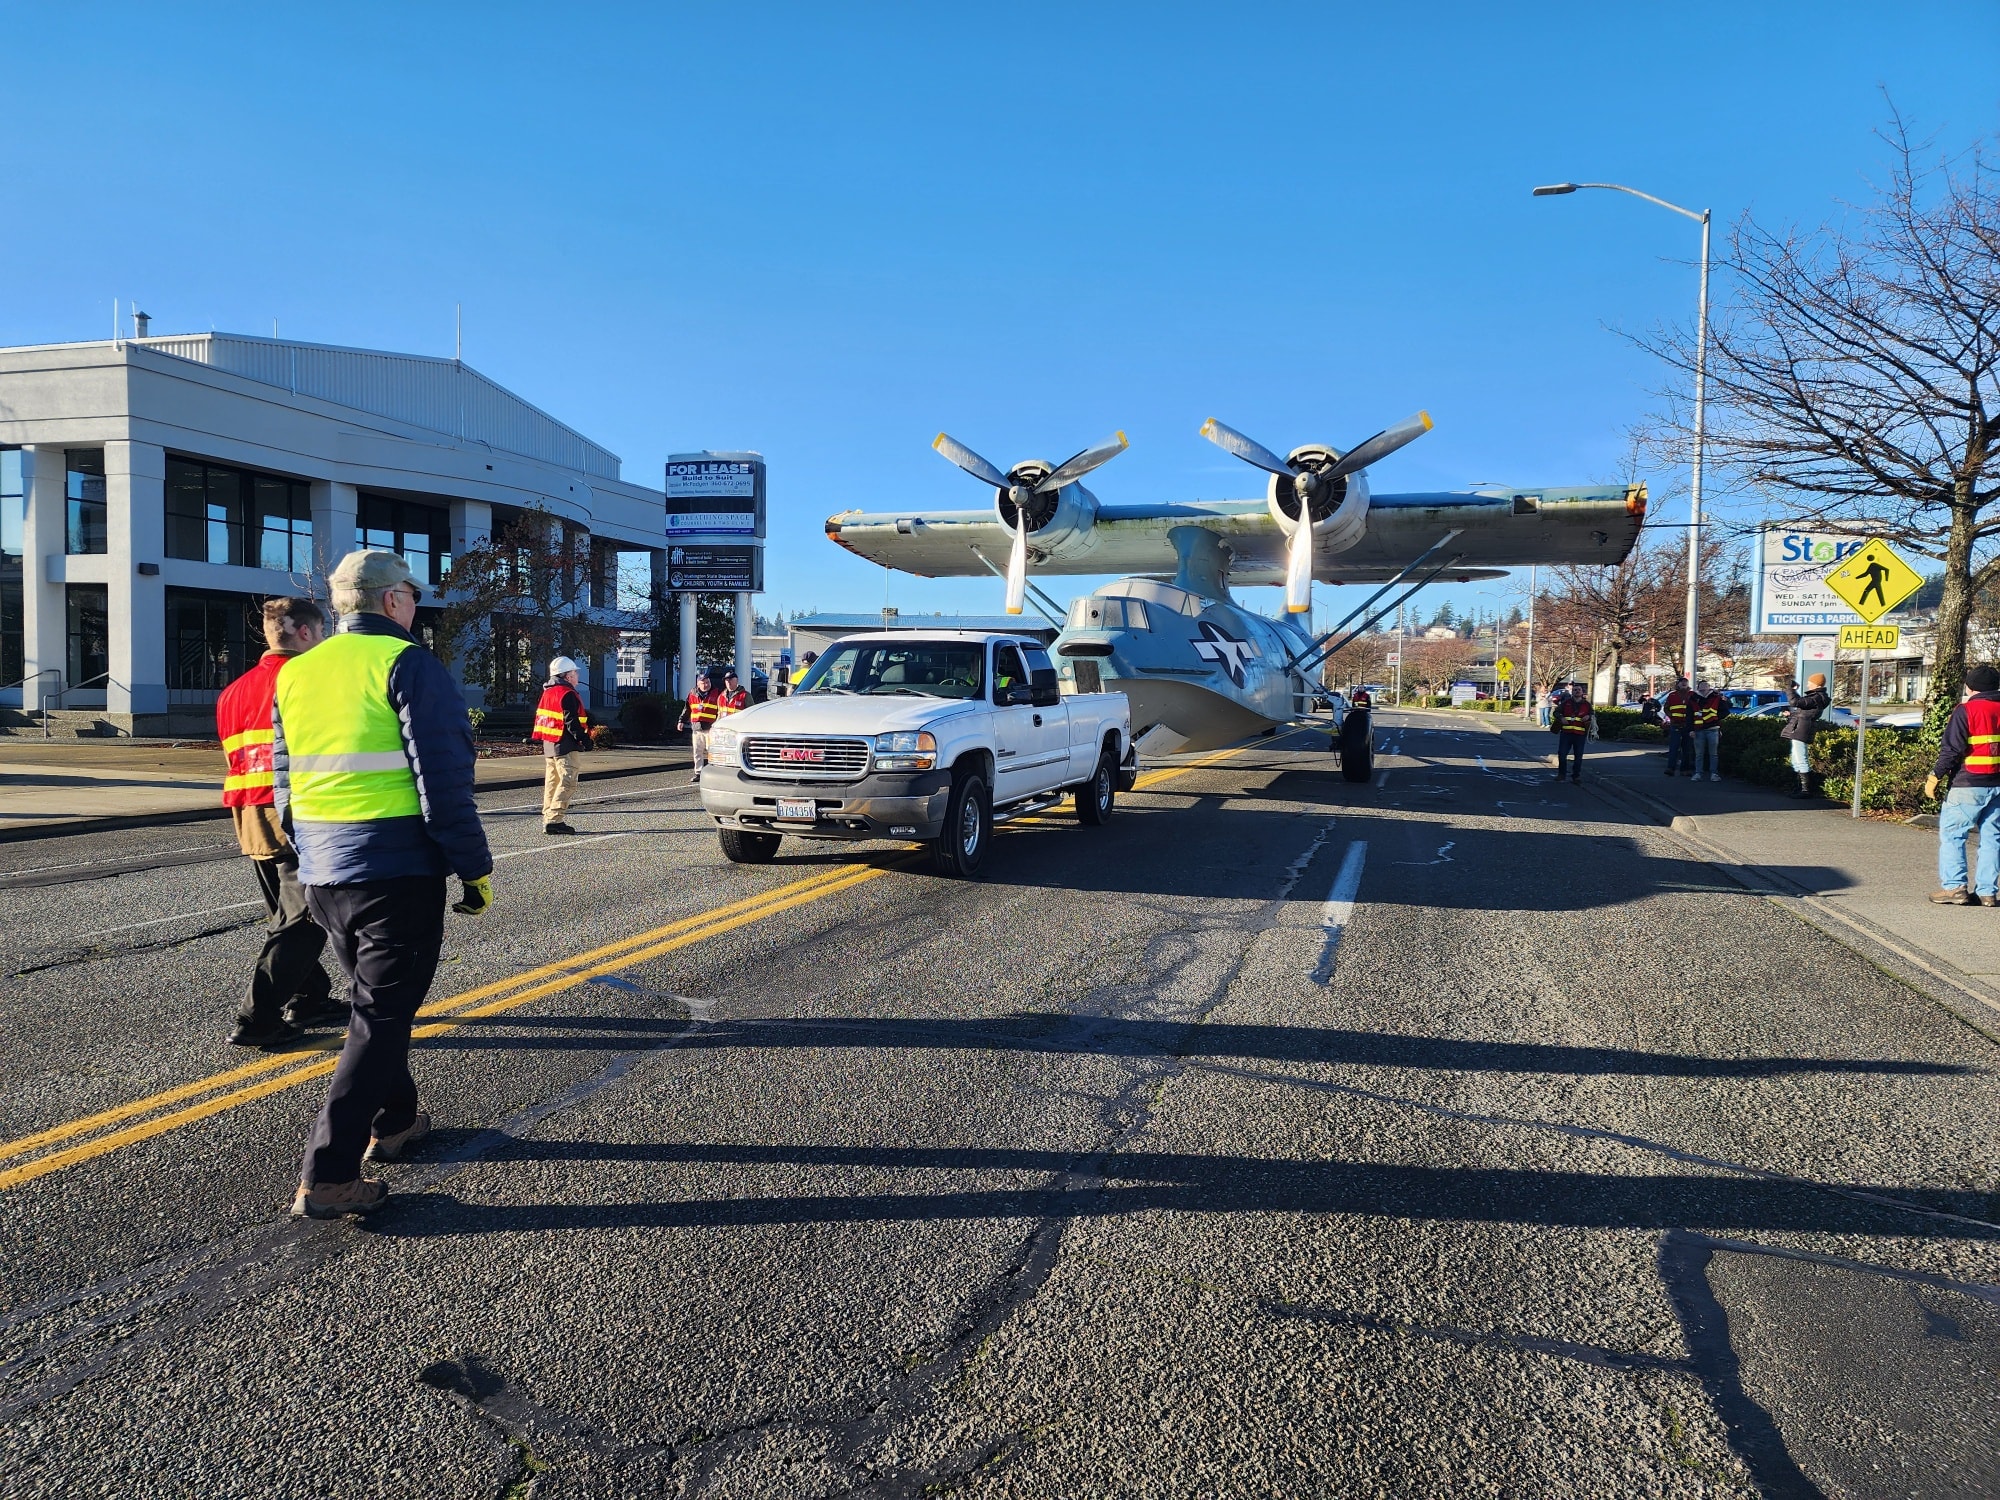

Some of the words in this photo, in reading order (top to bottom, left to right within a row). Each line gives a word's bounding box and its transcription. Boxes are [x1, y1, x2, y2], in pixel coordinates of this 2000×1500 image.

[669, 464, 698, 475] FOR
[701, 463, 749, 474] LEASE
[1820, 600, 1837, 608] 1pm
[1772, 614, 1816, 624] TICKETS
[1816, 614, 1825, 624] &
[1844, 630, 1895, 644] AHEAD
[780, 748, 825, 762] GMC
